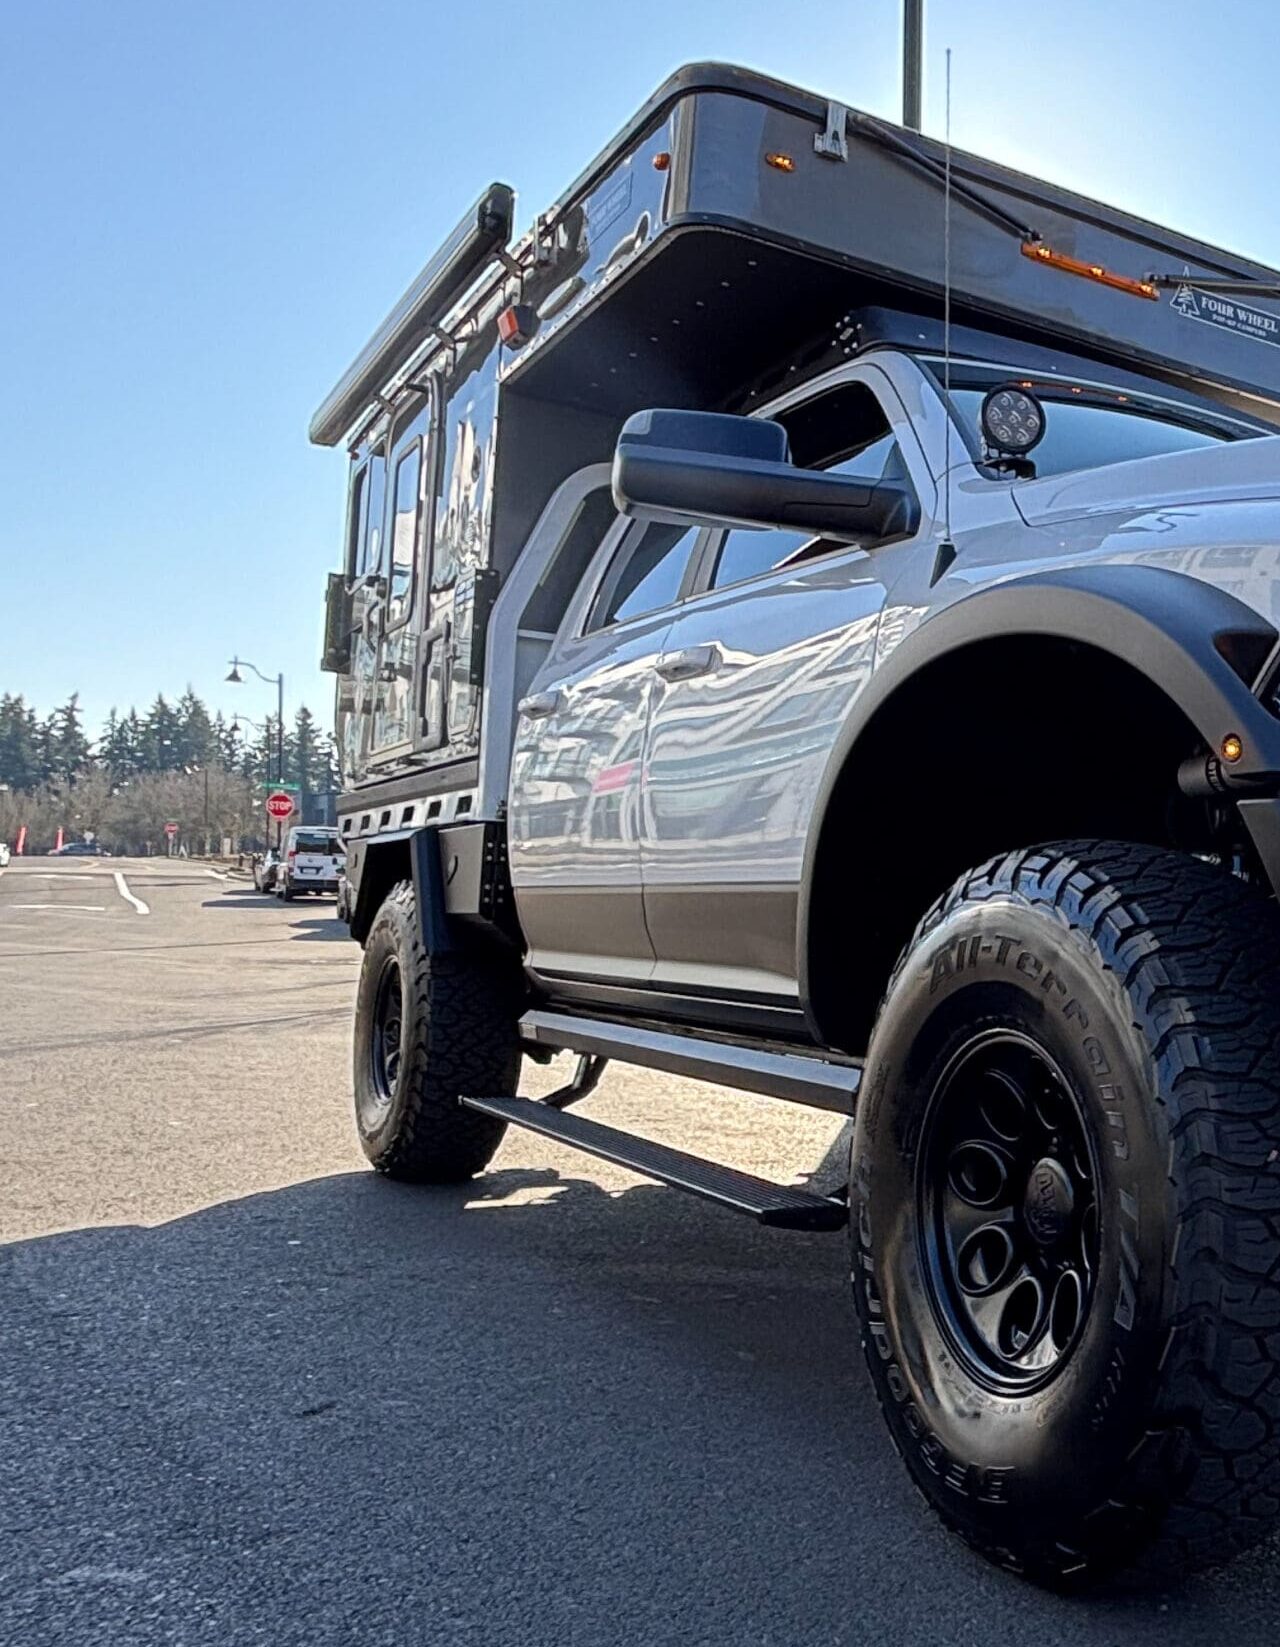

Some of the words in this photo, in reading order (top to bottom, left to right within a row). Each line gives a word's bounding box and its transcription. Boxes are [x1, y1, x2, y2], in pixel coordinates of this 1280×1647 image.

[1201, 296, 1235, 318] FOUR
[1236, 308, 1279, 333] WHEEL
[269, 801, 292, 811] STOP
[926, 934, 1131, 1161] All-Terrain
